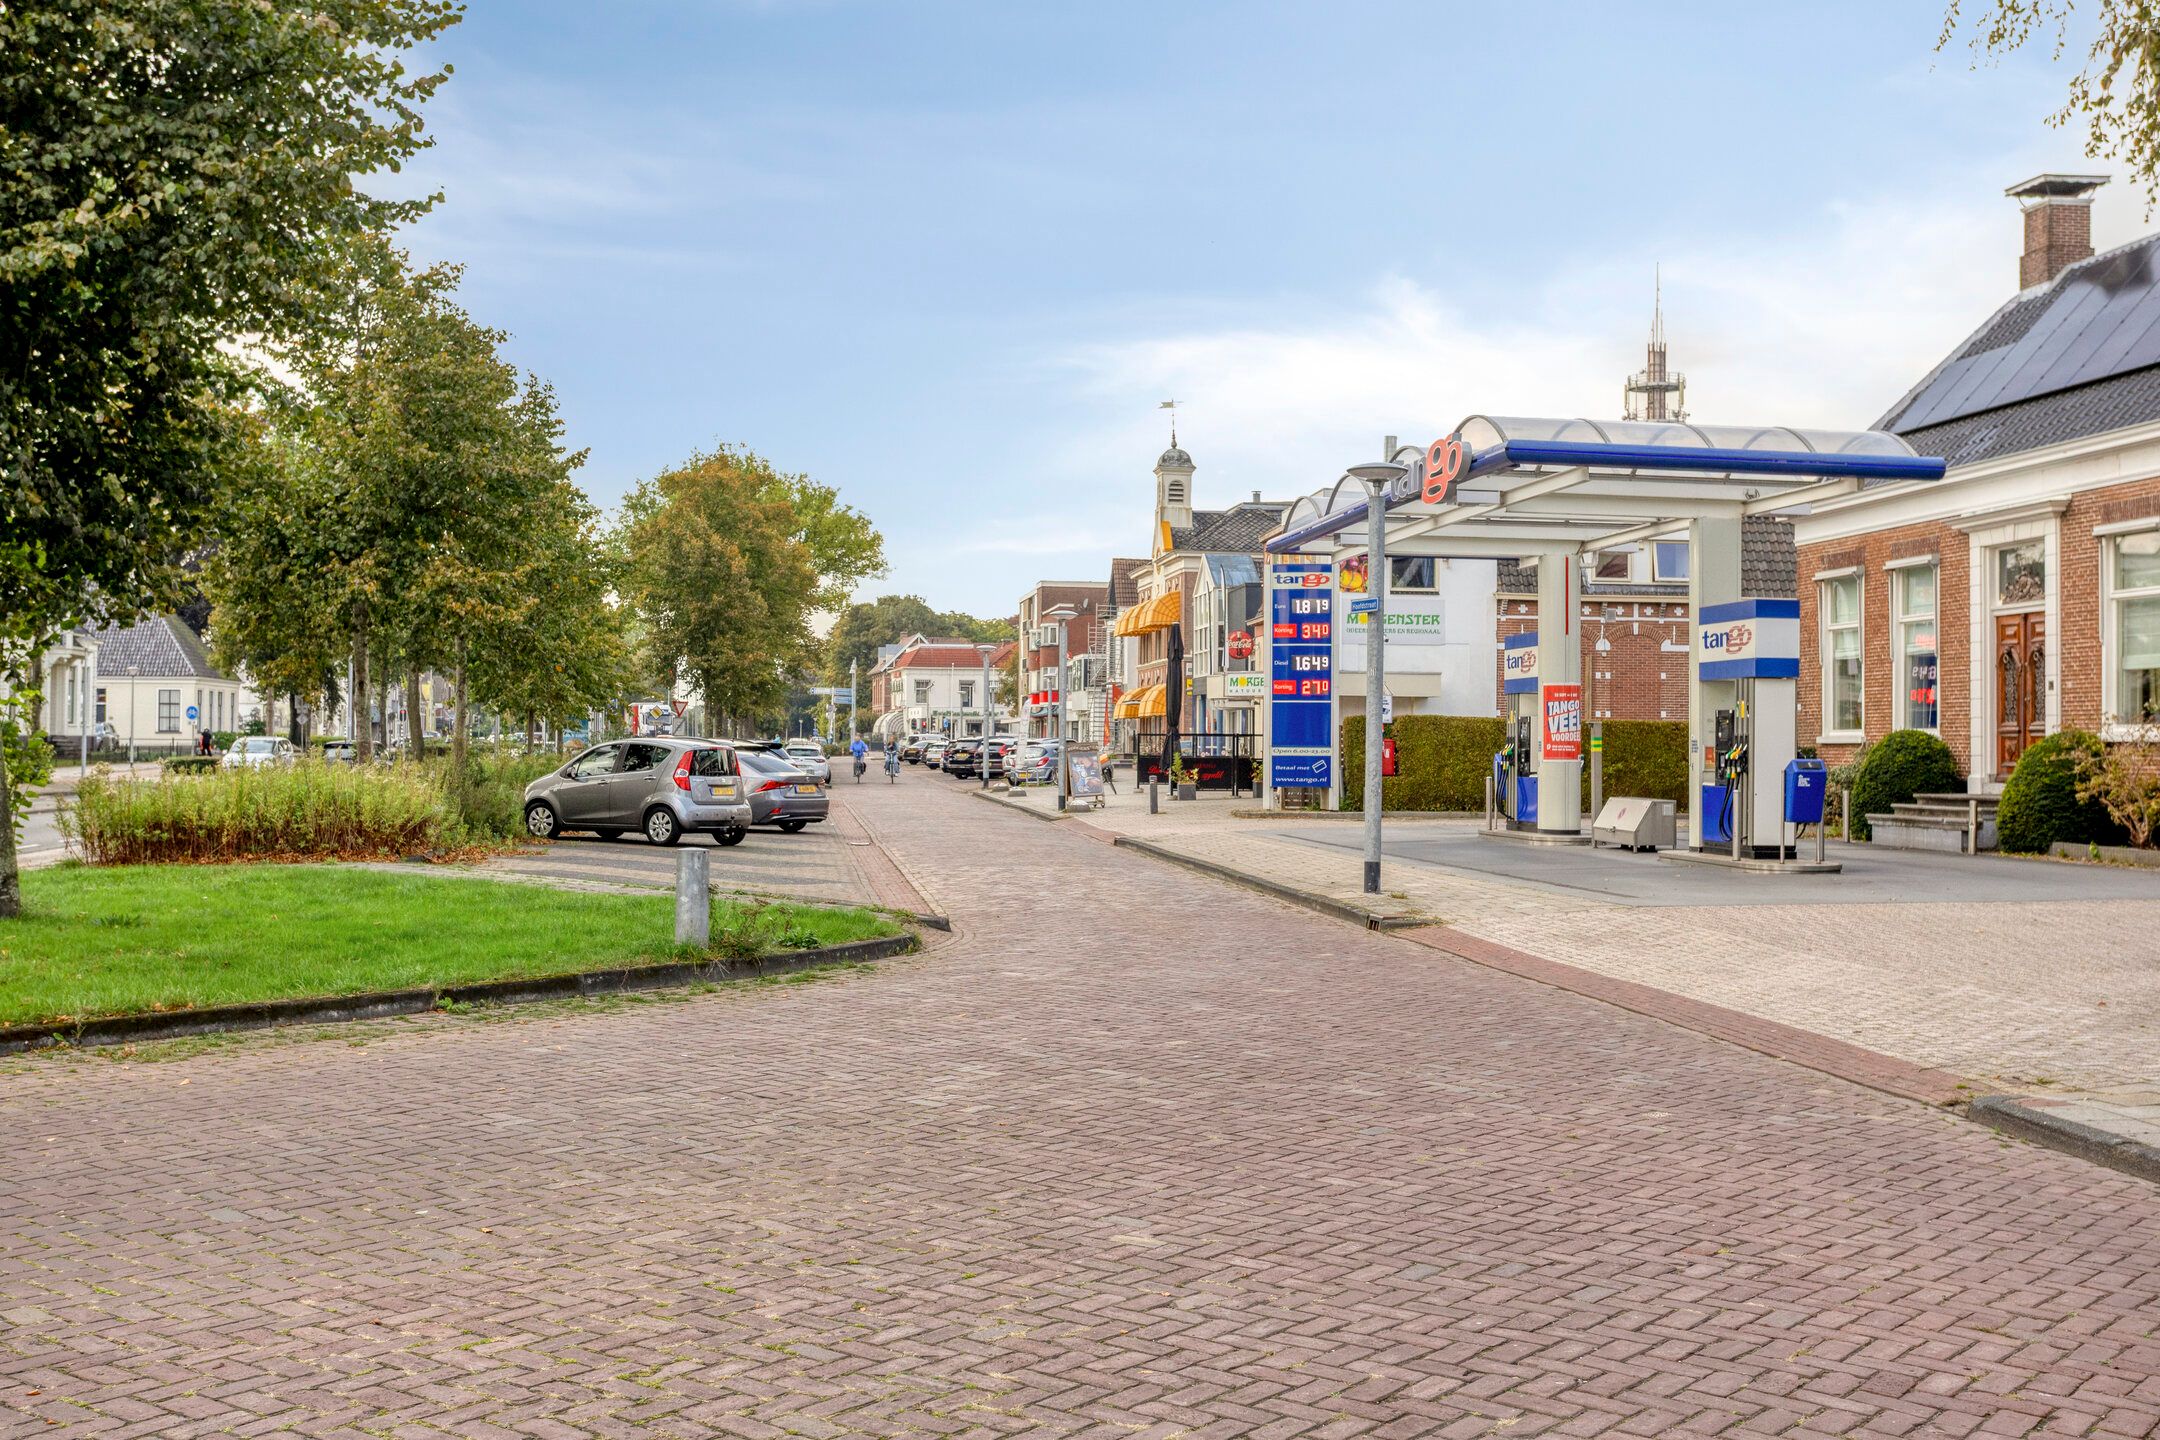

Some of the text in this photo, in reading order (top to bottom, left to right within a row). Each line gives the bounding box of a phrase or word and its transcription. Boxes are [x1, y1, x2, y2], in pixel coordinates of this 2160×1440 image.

[1274, 573, 1330, 588] tango
[1295, 599, 1329, 614] 1.819
[1346, 613, 1441, 626] MOENSTER
[1302, 624, 1329, 639] 340
[1701, 624, 1753, 655] tango
[1295, 656, 1329, 671] 1.649
[1506, 650, 1537, 674] tango
[1302, 680, 1329, 695] 270
[1547, 699, 1580, 716] TANGO
[1275, 776, 1328, 784] www.tango.nl
